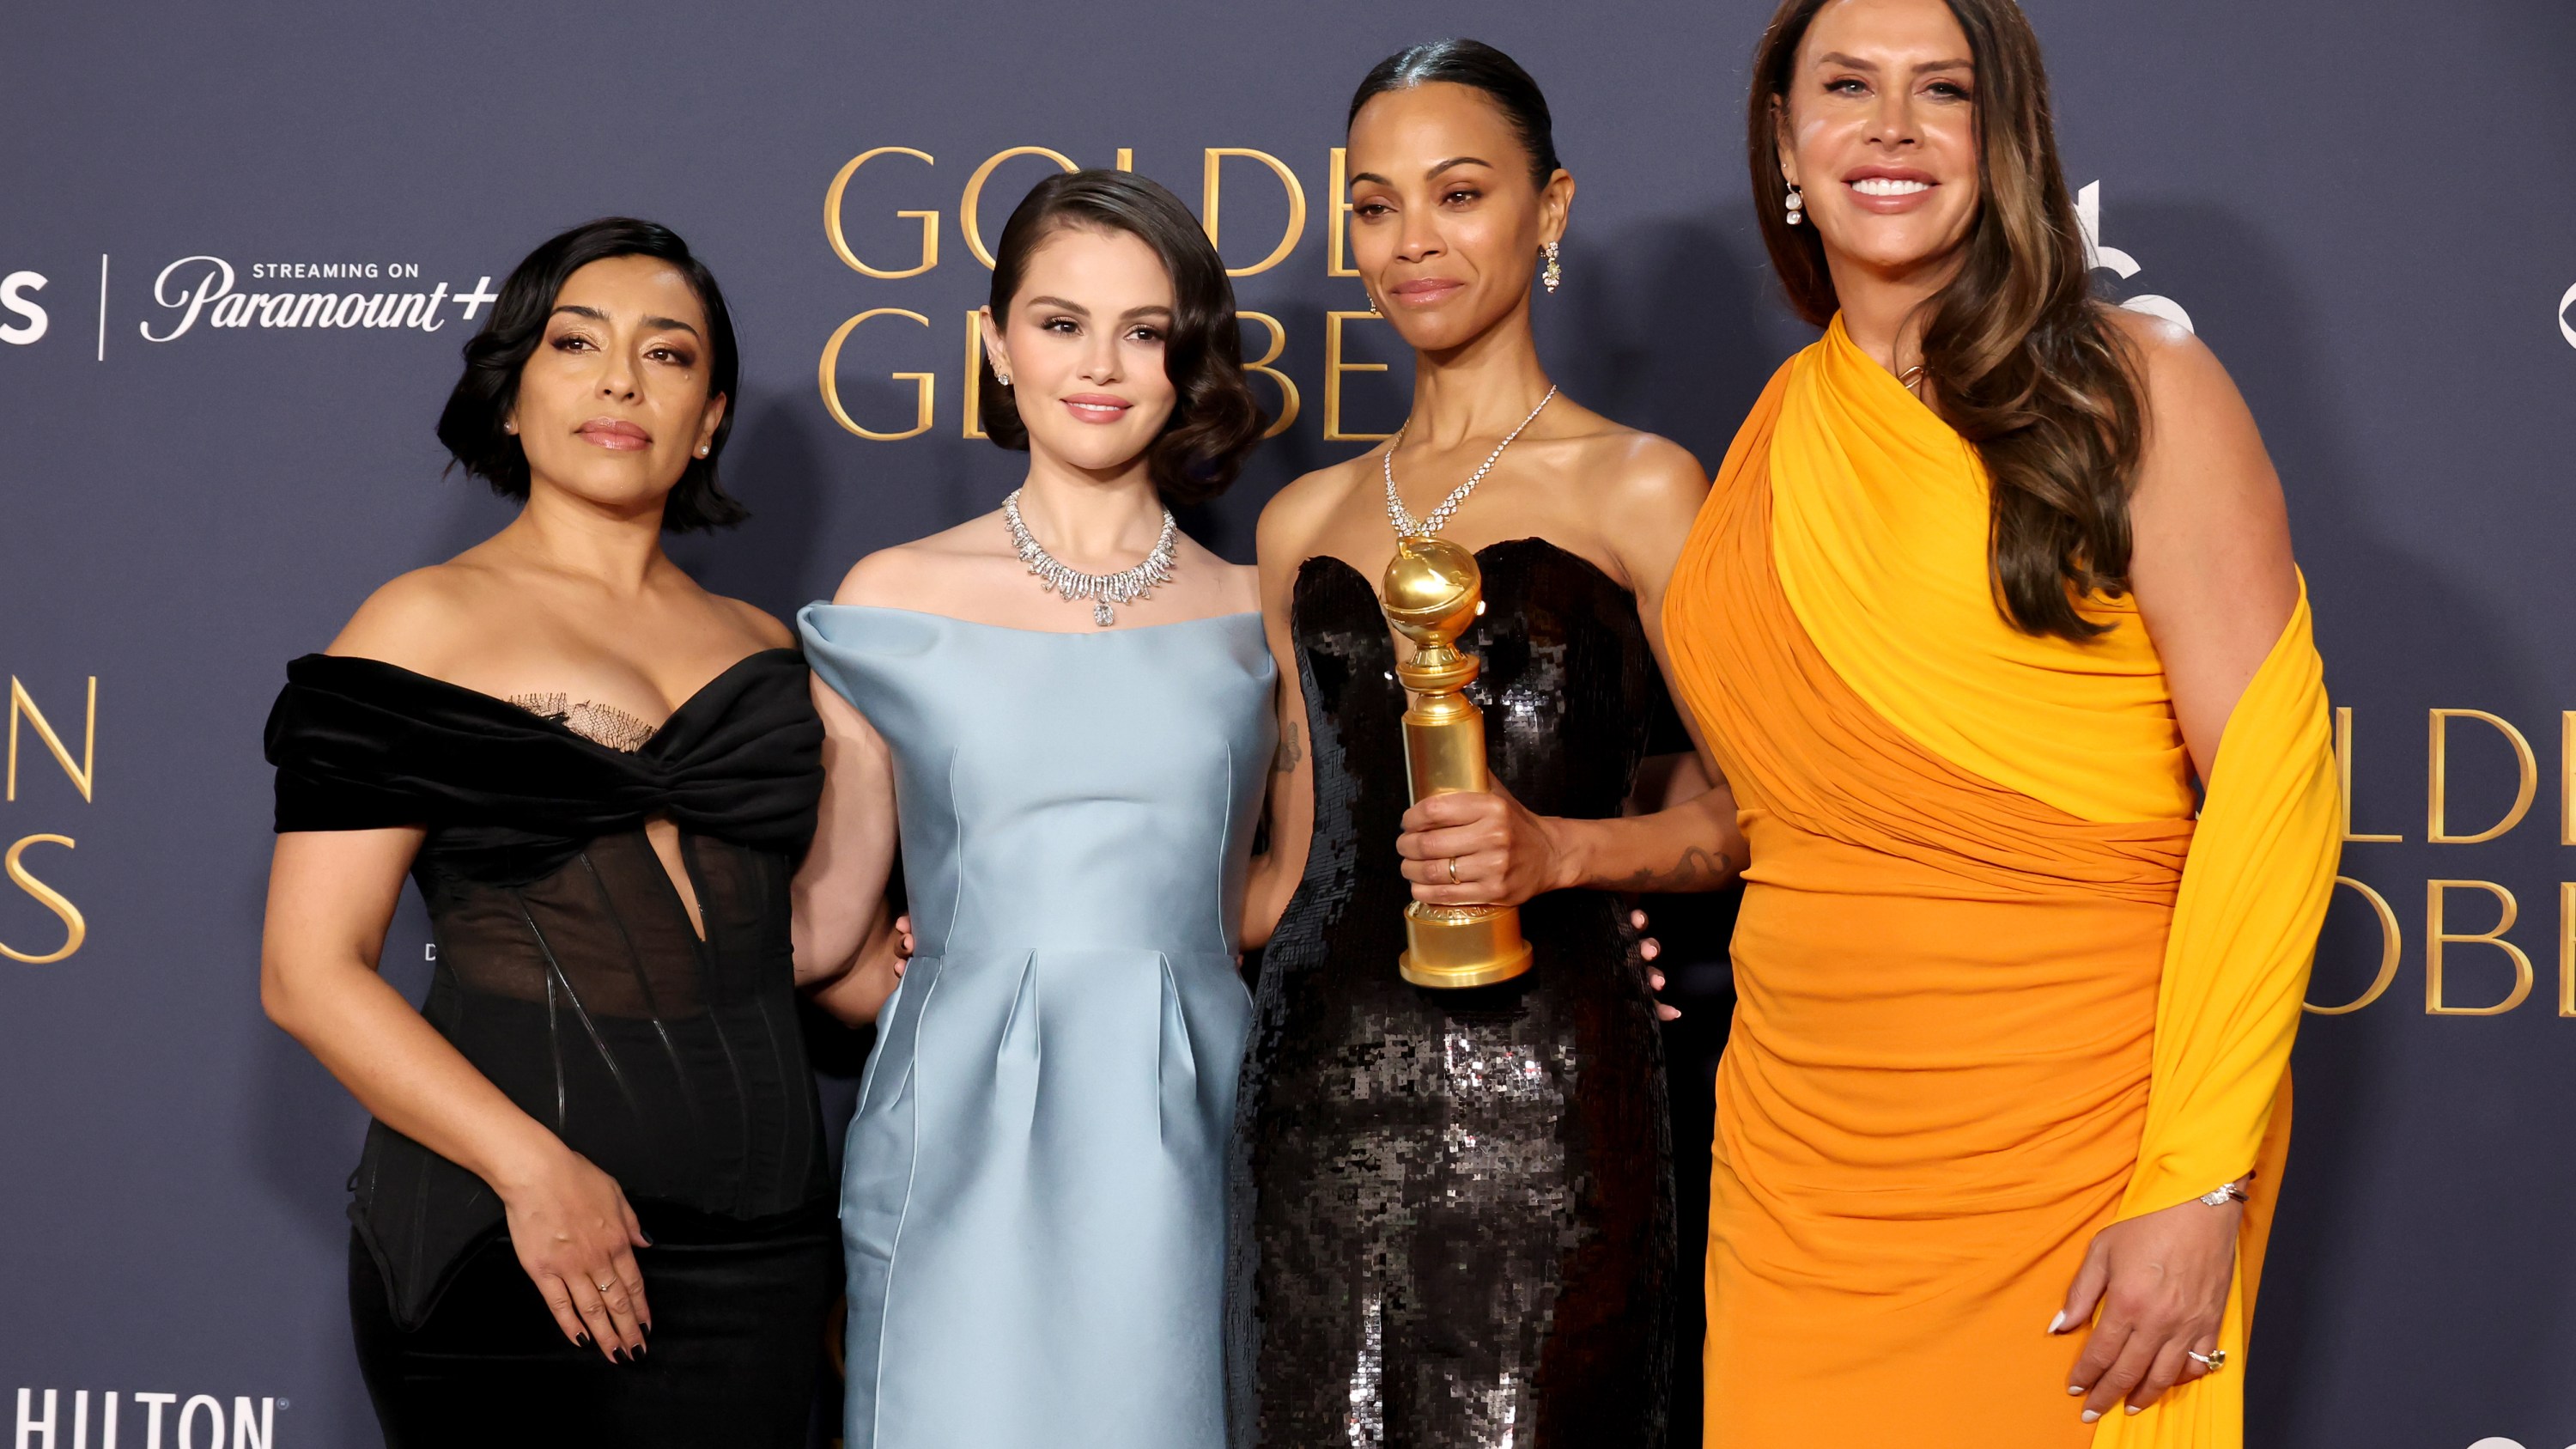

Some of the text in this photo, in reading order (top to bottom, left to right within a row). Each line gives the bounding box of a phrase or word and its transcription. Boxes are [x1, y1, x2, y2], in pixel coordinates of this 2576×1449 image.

[0, 271, 49, 345] S
[140, 255, 498, 343] Paramount+
[252, 263, 418, 278] STREAMING ON
[7, 674, 97, 804] N
[0, 833, 86, 964] S
